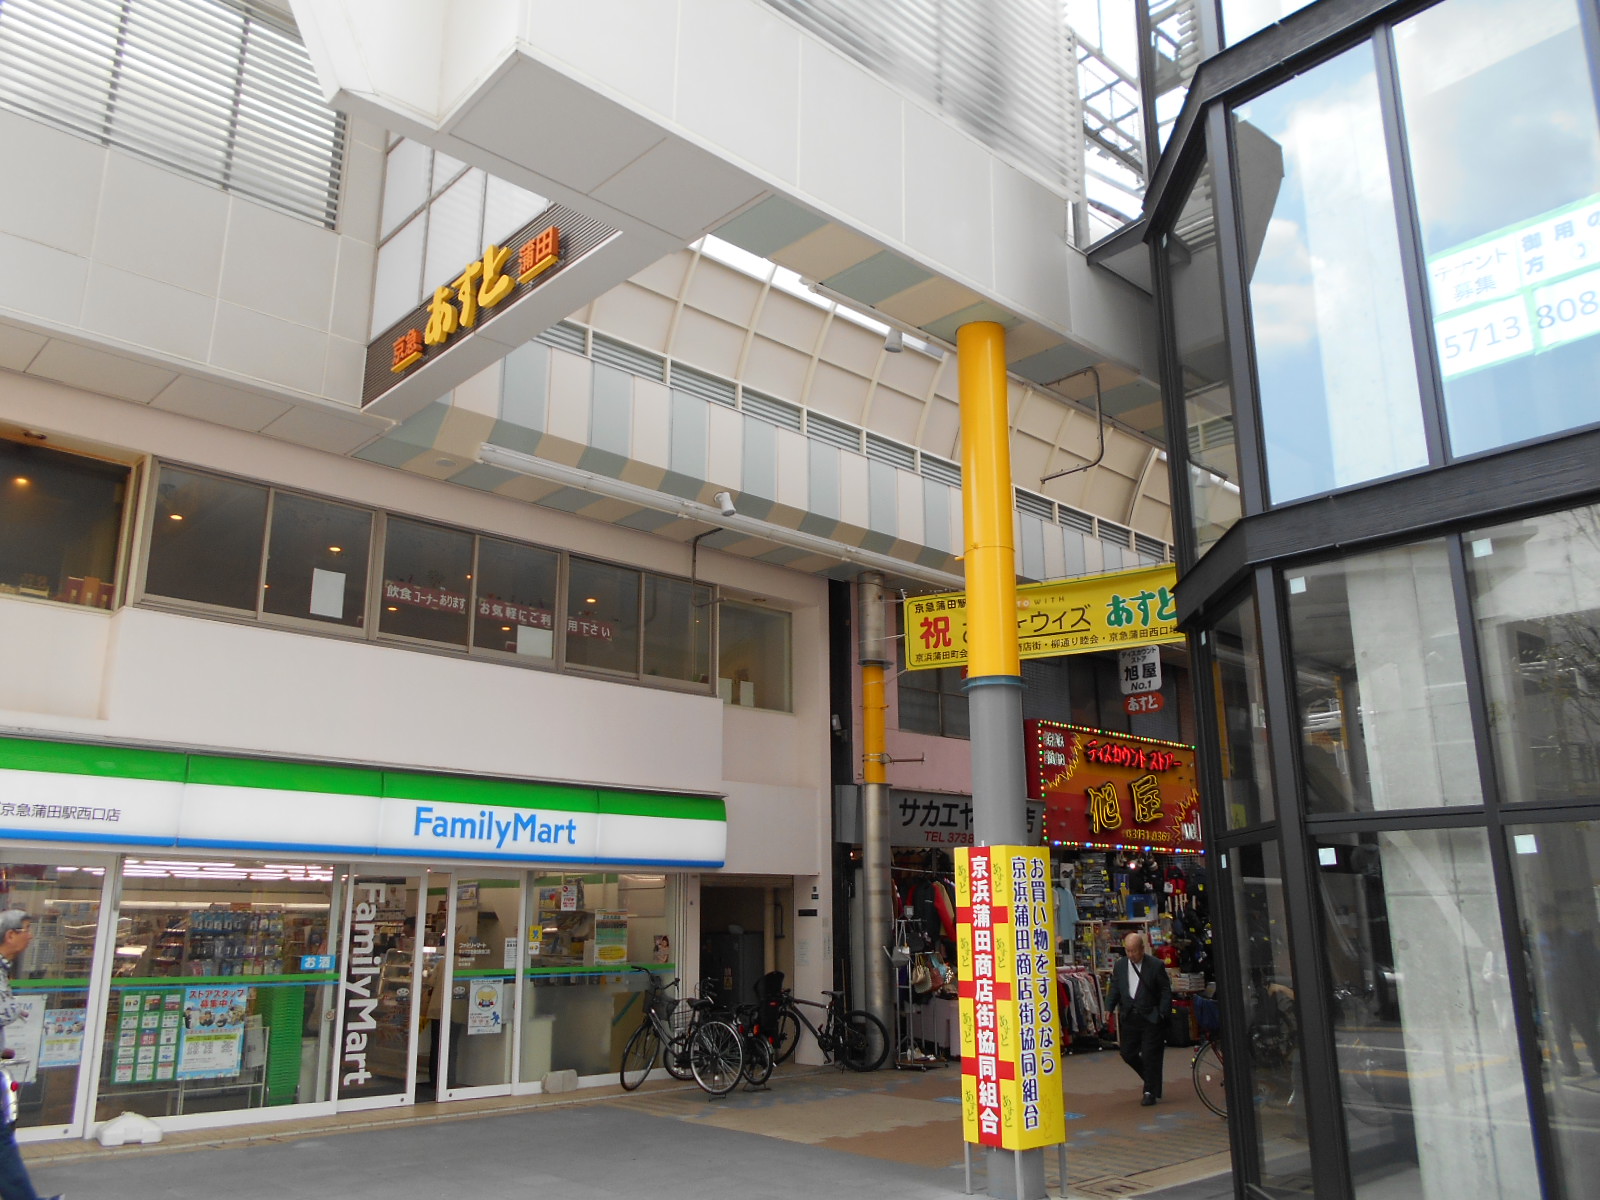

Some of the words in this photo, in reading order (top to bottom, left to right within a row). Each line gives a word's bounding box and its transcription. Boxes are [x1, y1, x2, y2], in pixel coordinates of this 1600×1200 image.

[424, 244, 517, 346] あすと
[517, 225, 561, 276] 蒲田
[1434, 247, 1508, 282] テナント
[1444, 315, 1522, 360] 5713
[1034, 596, 1066, 606] WITH
[1106, 586, 1178, 628] あすと
[920, 616, 952, 650] 祝
[1124, 662, 1158, 682] 旭屋
[1130, 680, 1152, 691] No.1
[1127, 694, 1159, 712] あすと
[1088, 774, 1164, 834] 旭屋
[413, 805, 577, 849] FamilyMart
[924, 831, 944, 842] TEL
[304, 956, 331, 969] お酒
[1029, 857, 1056, 1075] お買い物をするなら
[343, 882, 387, 1087] FamilyMart
[970, 855, 999, 1135] 京浜蒲田商店街協同組合
[1011, 856, 1039, 1130] 京浜蒲田商店街協同組合
